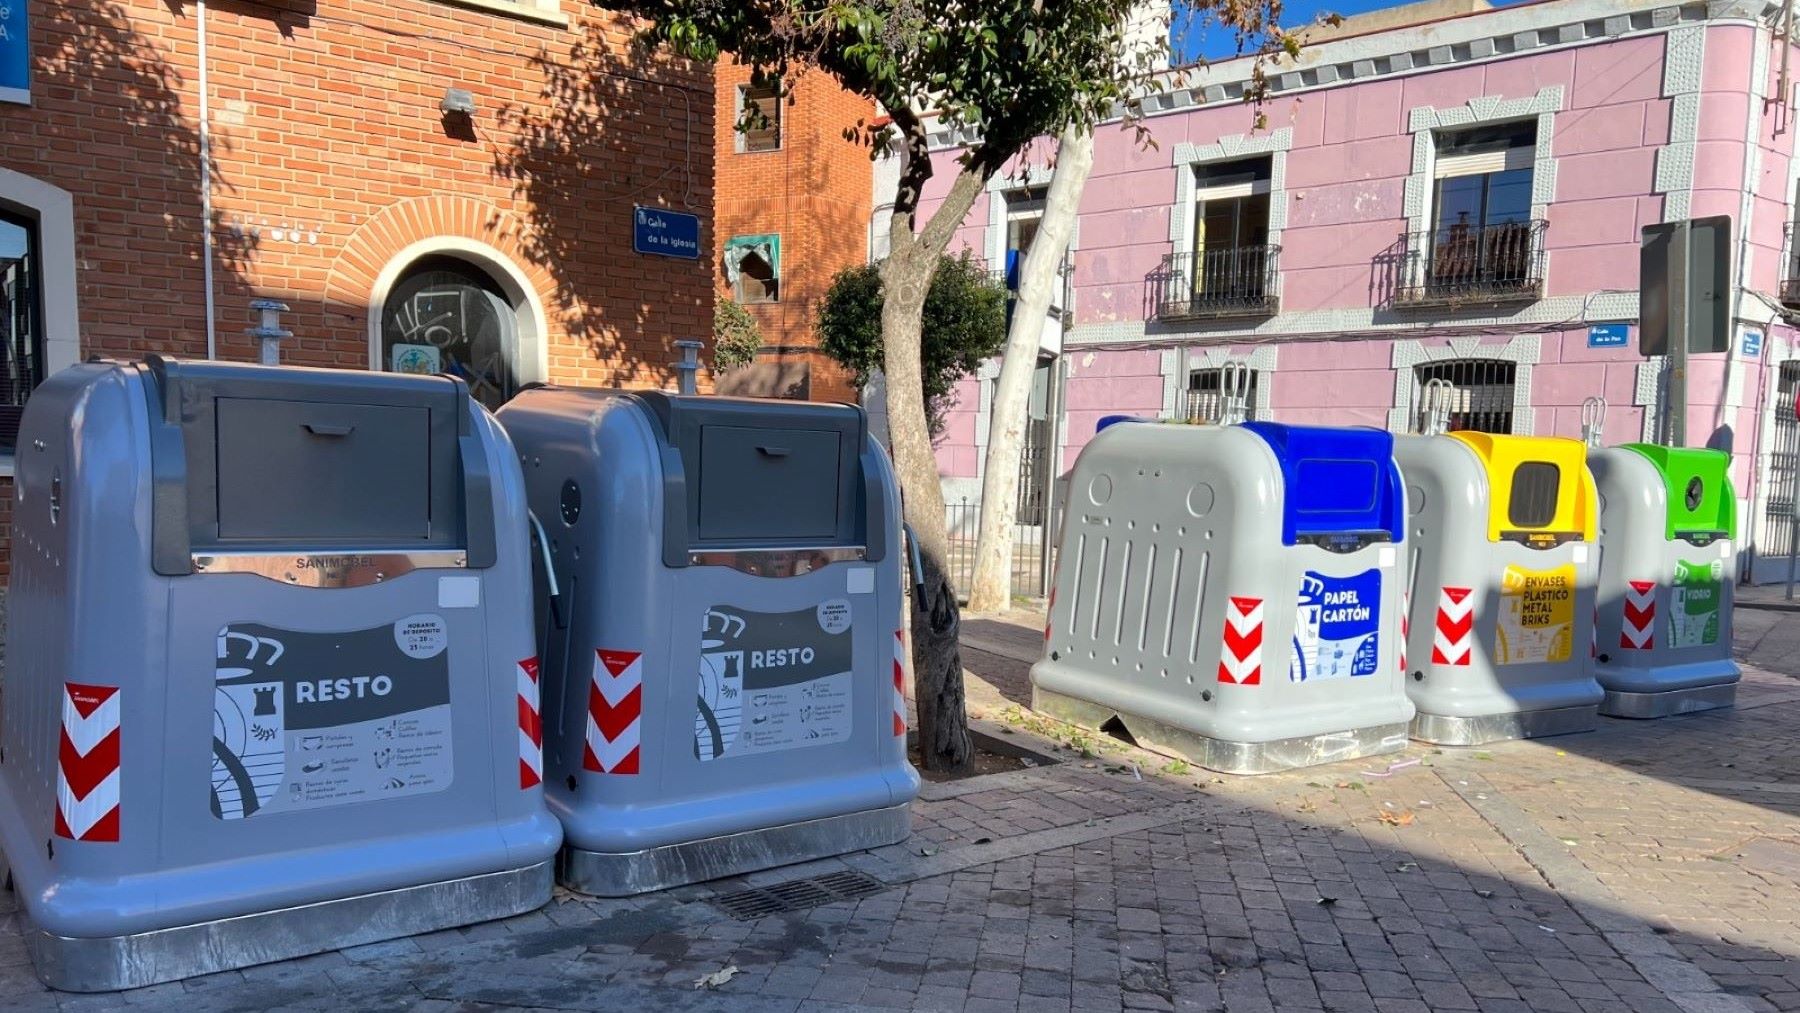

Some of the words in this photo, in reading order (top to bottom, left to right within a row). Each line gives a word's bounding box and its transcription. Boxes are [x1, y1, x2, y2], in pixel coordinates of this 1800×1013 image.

[648, 234, 658, 244] de
[660, 235, 668, 245] la
[671, 237, 696, 249] Iglesia
[1525, 576, 1566, 588] ENVASES
[1324, 590, 1360, 605] PAPEL
[1687, 589, 1712, 600] VIDRIO
[1322, 604, 1370, 623] CARTÓN
[1522, 602, 1553, 613] METAL
[1521, 614, 1550, 626] BRIKS
[751, 647, 815, 669] RESTO
[296, 675, 393, 704] RESTO
